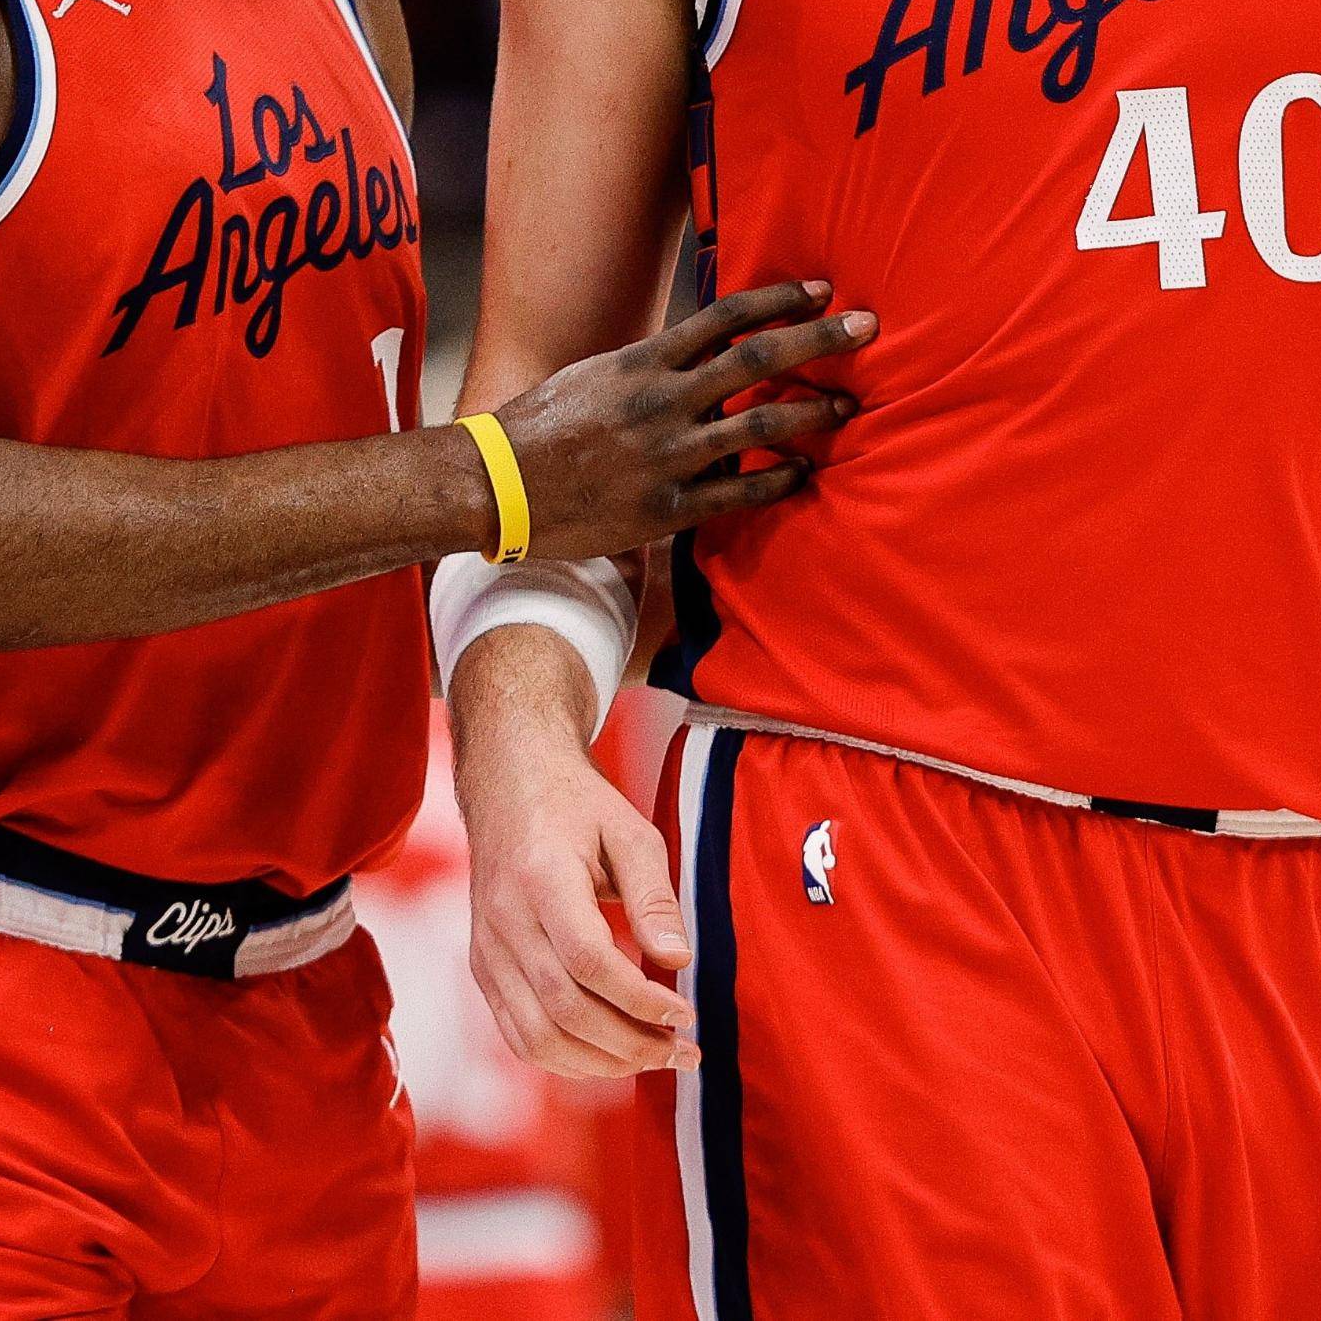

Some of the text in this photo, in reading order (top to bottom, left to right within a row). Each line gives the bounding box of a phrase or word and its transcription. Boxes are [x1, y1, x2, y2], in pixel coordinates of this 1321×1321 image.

[204, 51, 337, 194] Los
[100, 127, 418, 358] Angeles
[370, 327, 406, 434] 1
[146, 899, 236, 954] Clips
